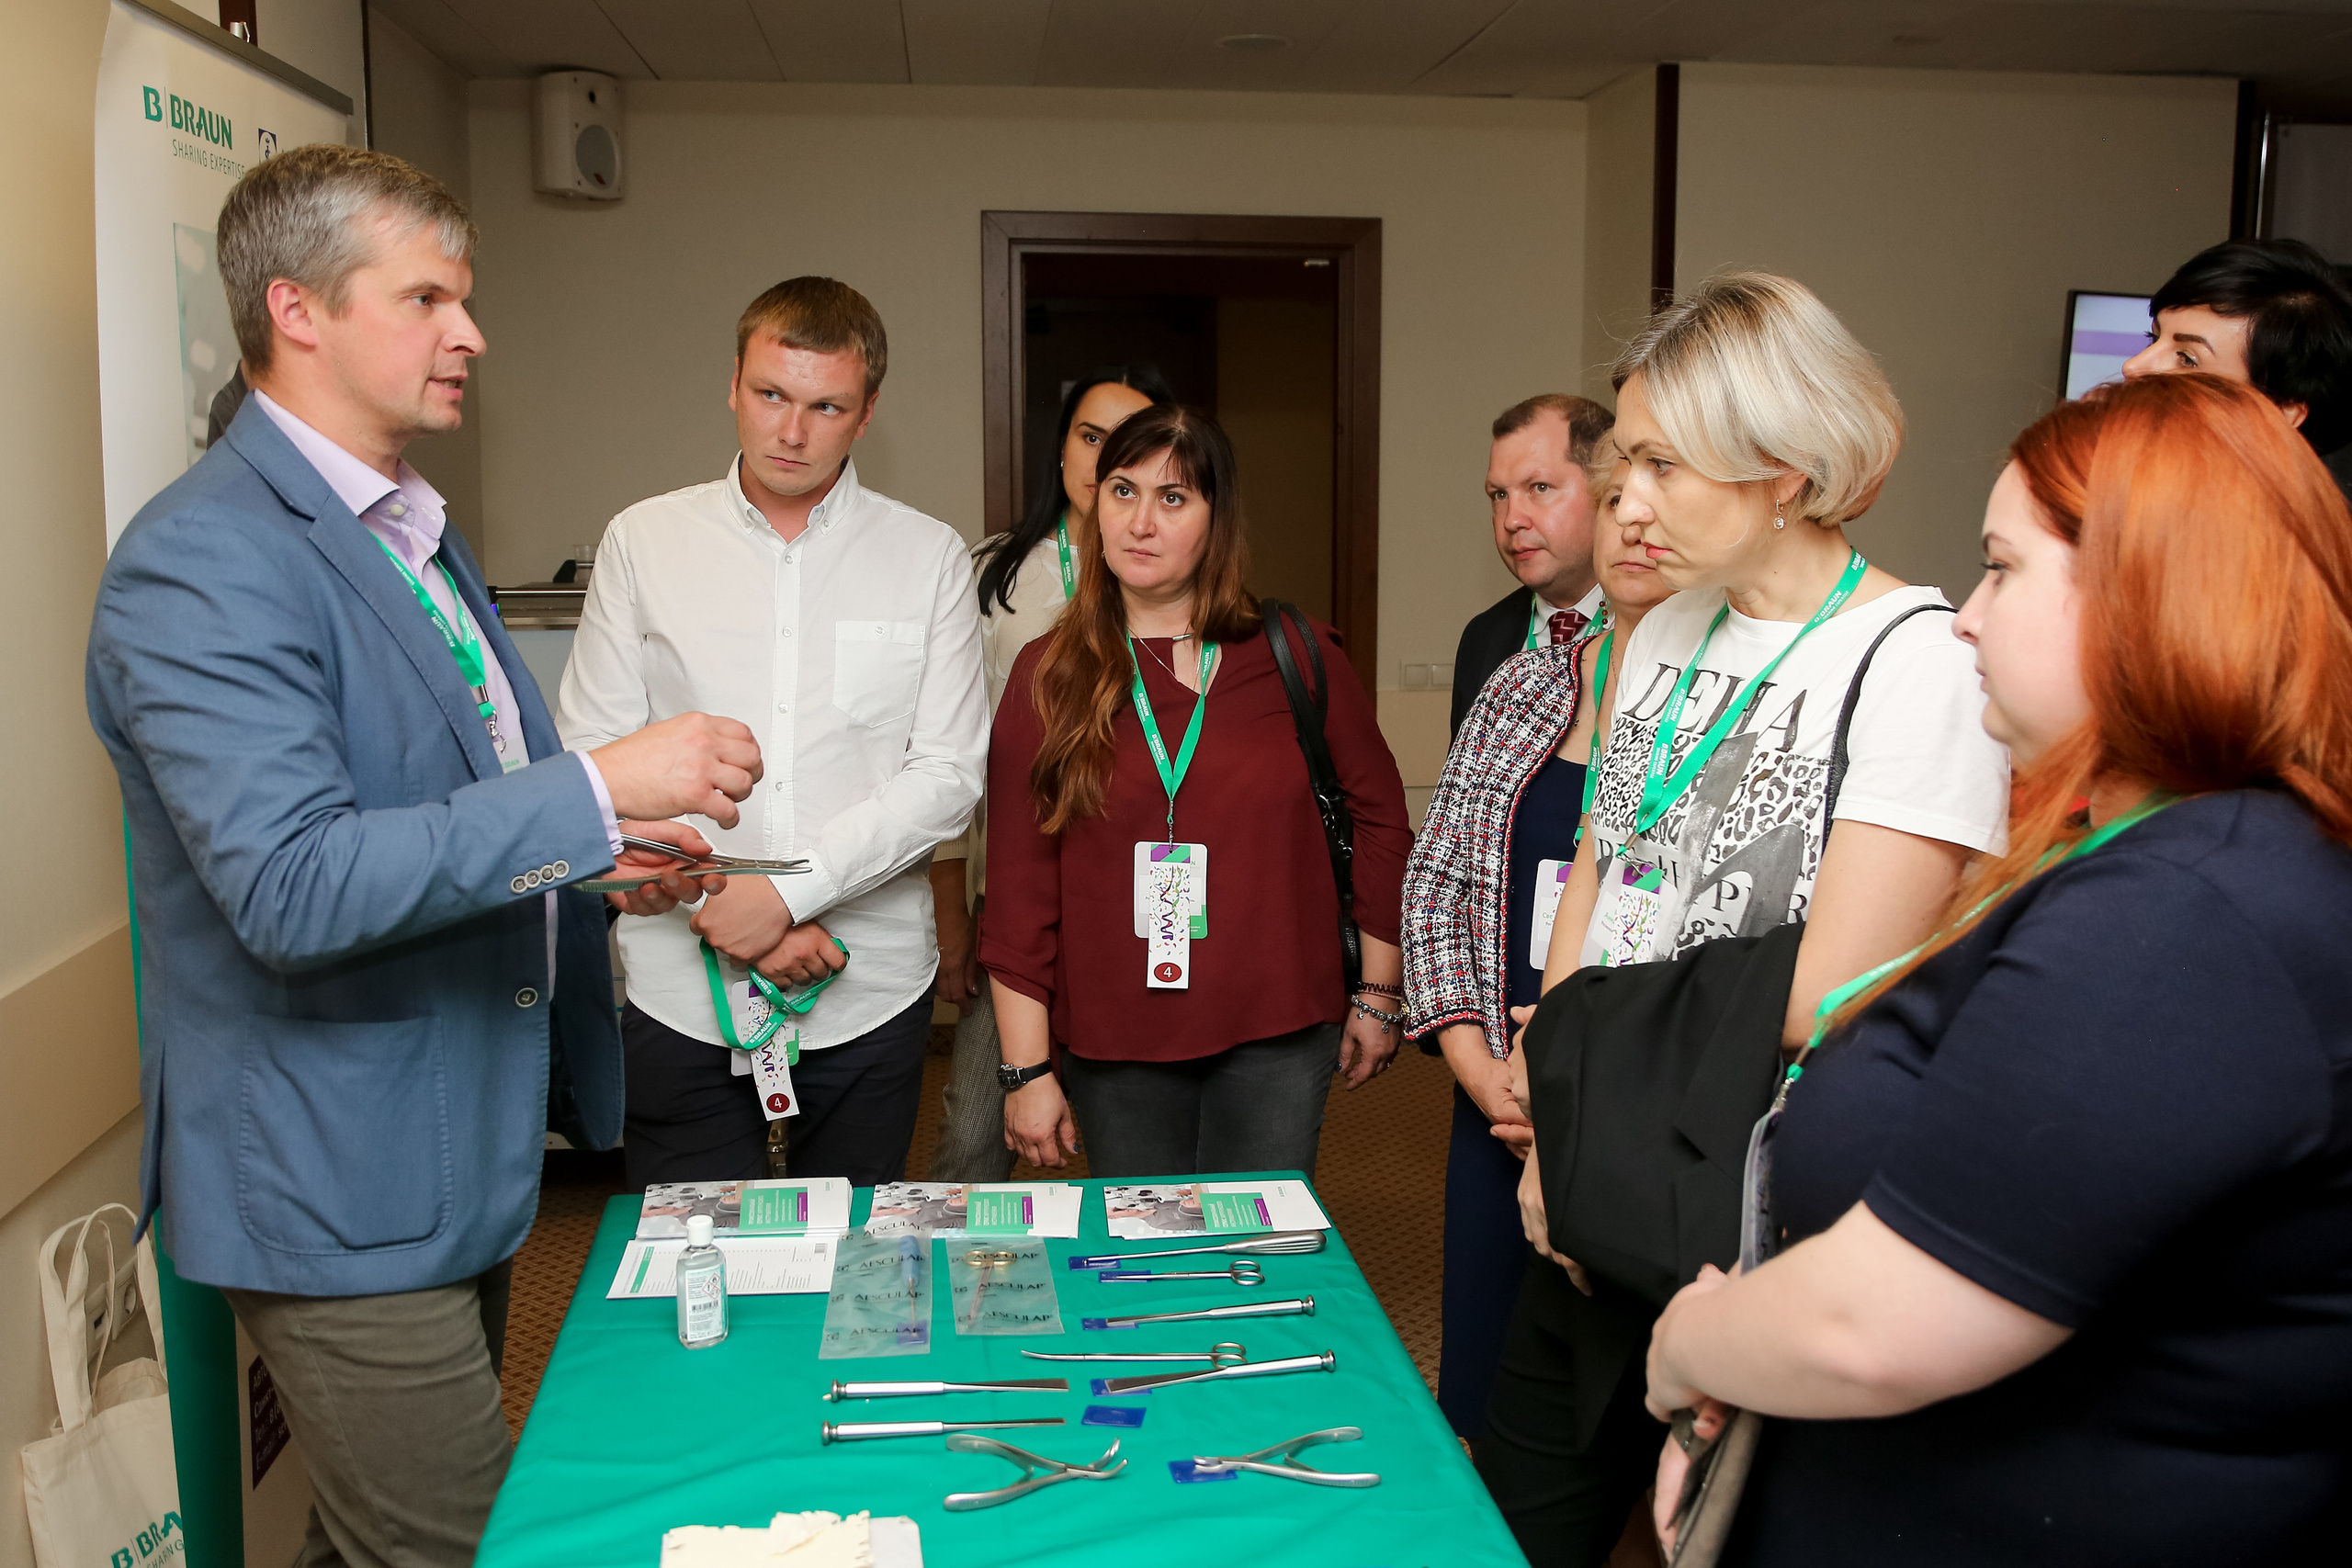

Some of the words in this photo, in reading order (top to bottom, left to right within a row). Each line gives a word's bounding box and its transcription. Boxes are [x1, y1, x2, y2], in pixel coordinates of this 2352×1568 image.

[170, 94, 232, 150] BRAUN
[172, 139, 208, 168] SHARING
[1163, 966, 1172, 978] 4
[774, 1098, 783, 1108] 4
[135, 1511, 184, 1559] BRA
